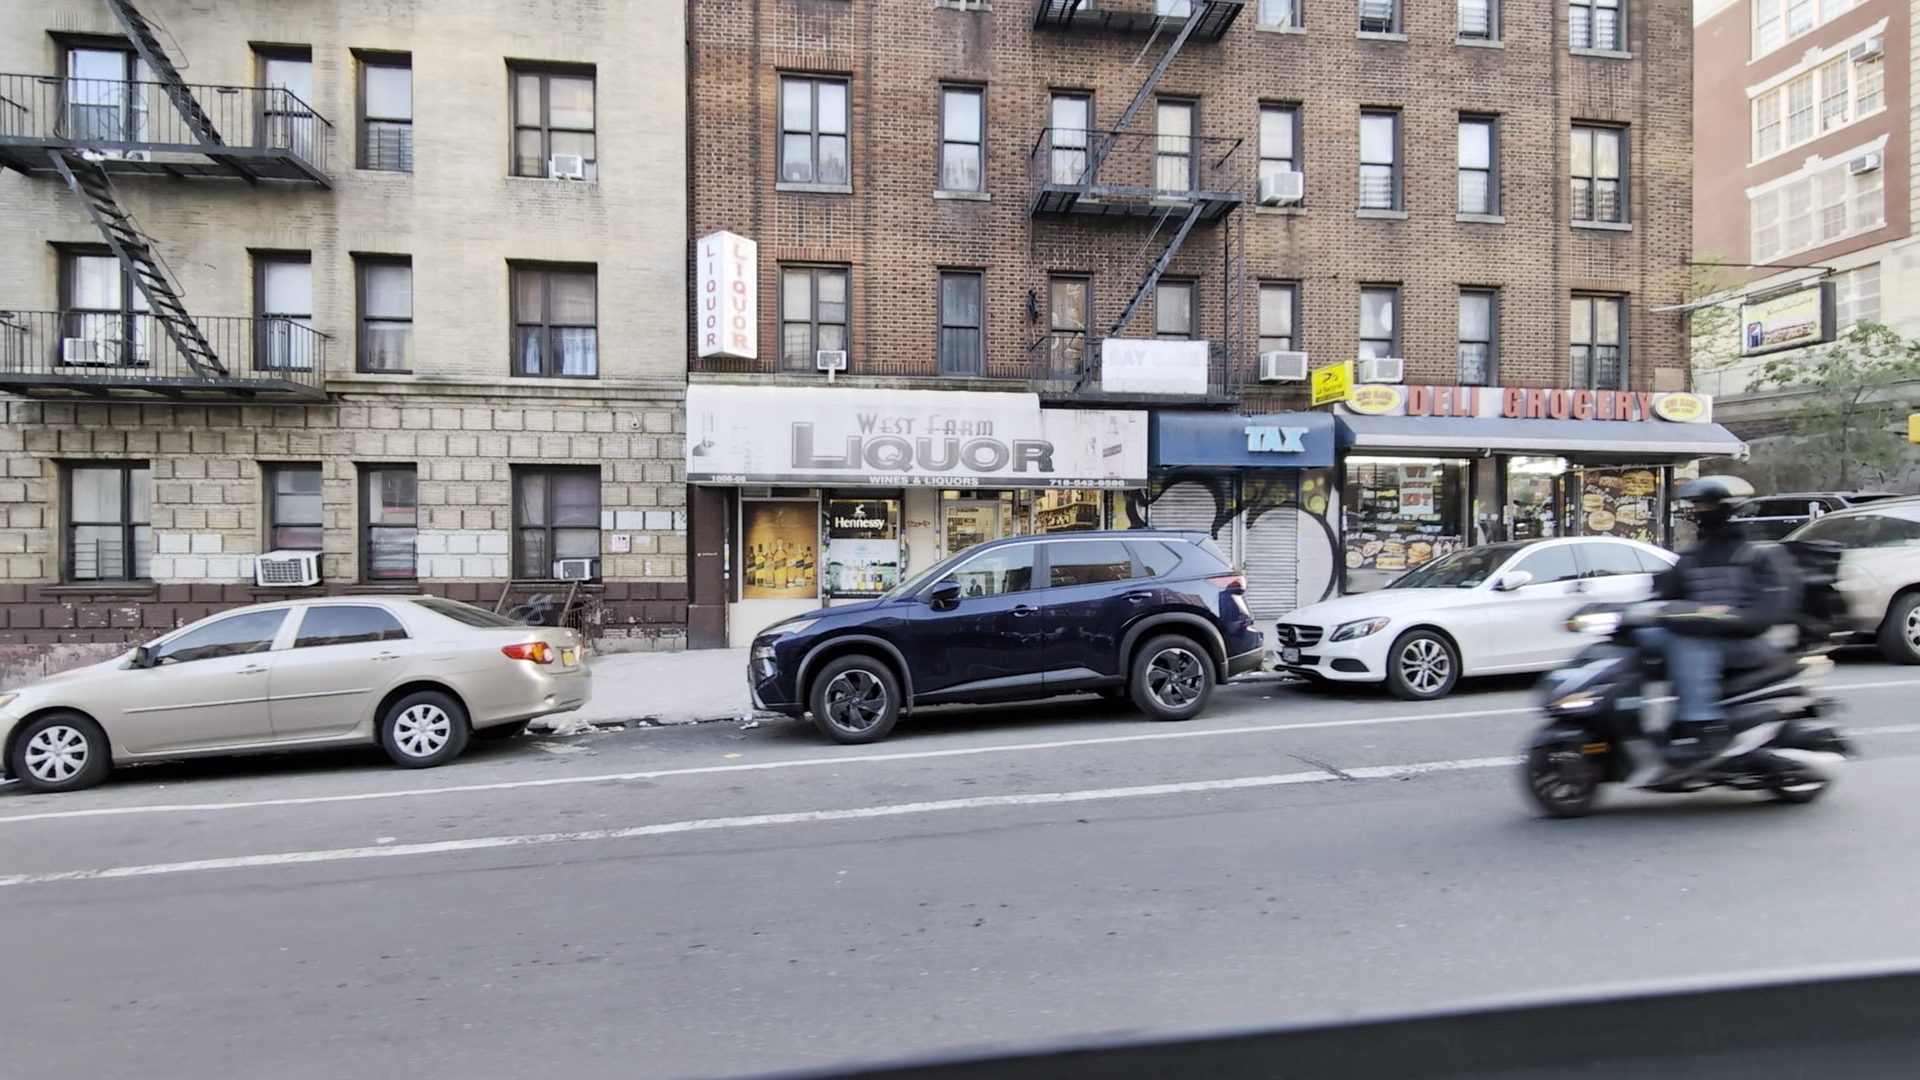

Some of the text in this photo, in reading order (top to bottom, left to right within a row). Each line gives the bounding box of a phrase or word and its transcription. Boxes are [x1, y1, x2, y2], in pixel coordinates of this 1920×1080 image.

[706, 244, 716, 347] LIQUOR
[732, 244, 749, 349] LIQUOR
[1407, 385, 1479, 417] DELI
[1502, 386, 1654, 421] GROCERY
[856, 412, 994, 437] WEST FARM
[791, 422, 1055, 472] LIQUOR
[1244, 426, 1309, 453] TAX
[869, 475, 979, 486] WINES & LIQUORS
[1405, 466, 1427, 478] WE
[1401, 493, 1432, 506] EBT
[835, 516, 885, 529] Hennessy
